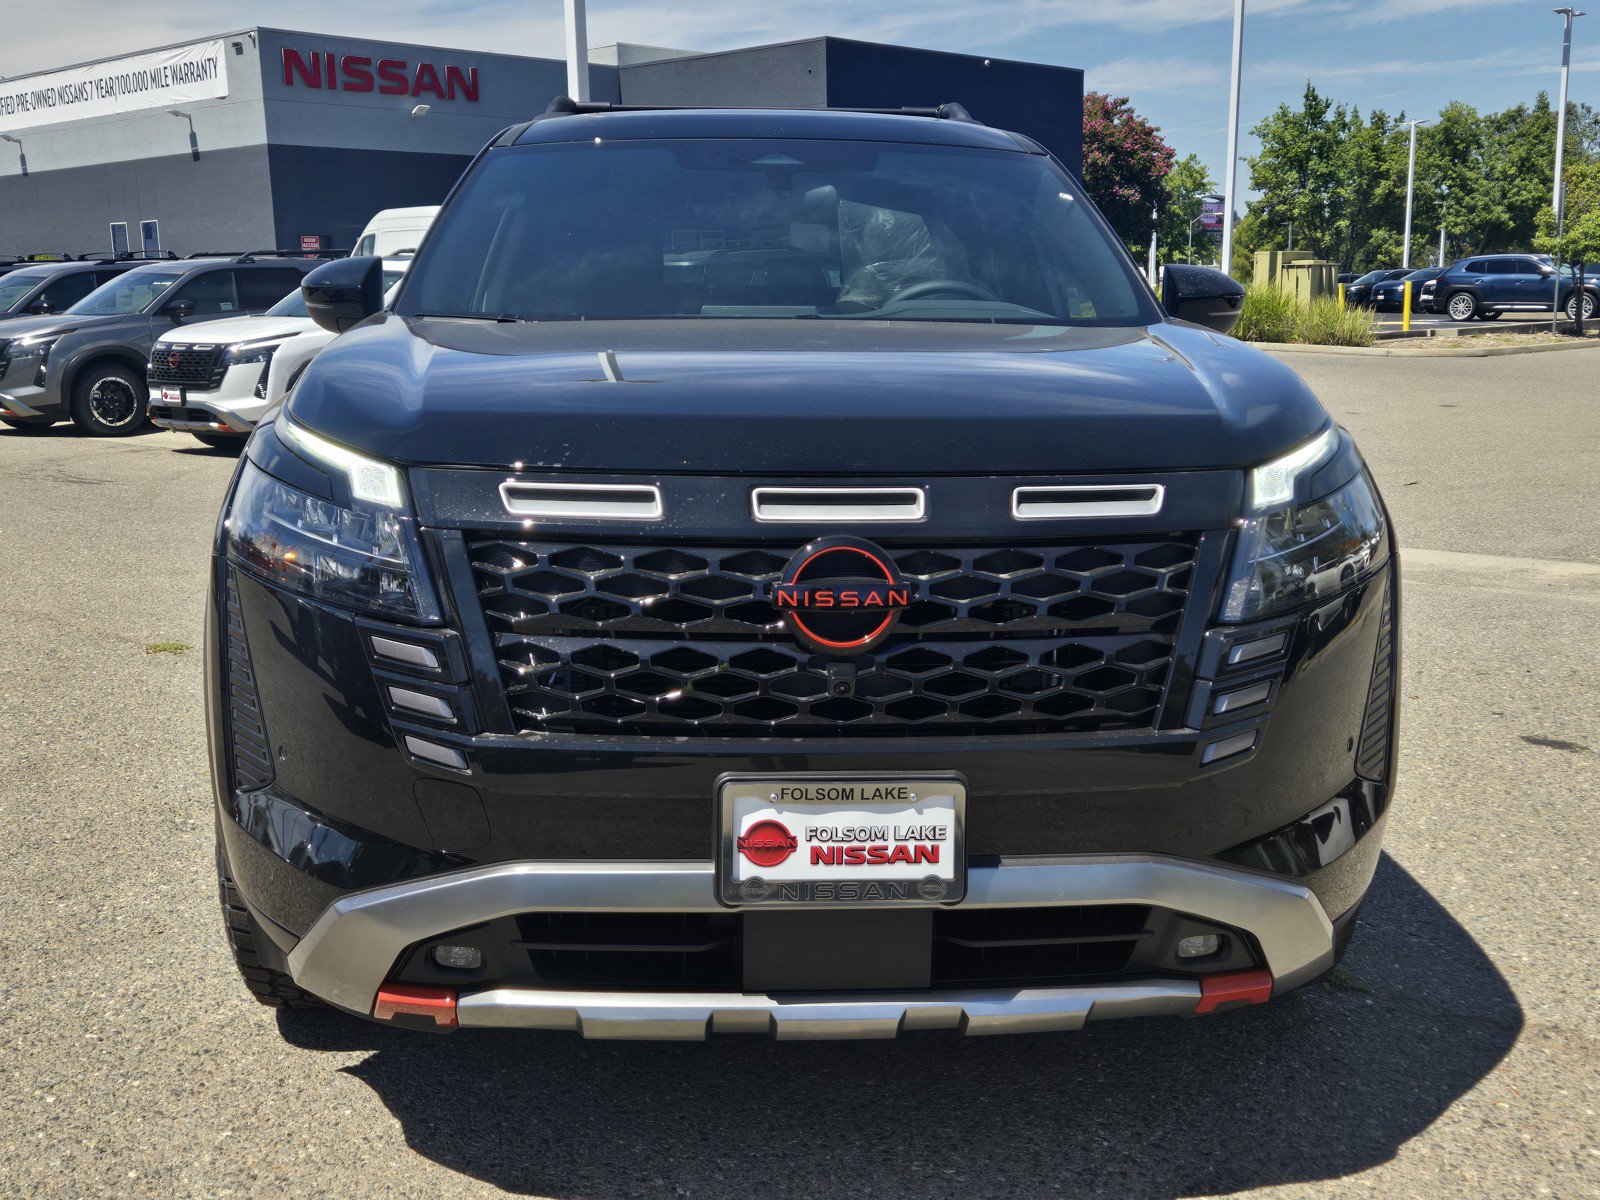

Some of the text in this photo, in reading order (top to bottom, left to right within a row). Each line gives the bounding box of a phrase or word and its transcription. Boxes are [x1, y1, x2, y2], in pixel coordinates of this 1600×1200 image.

[16, 87, 57, 113] PRE-OWNED
[57, 81, 88, 106] NISSANS
[88, 80, 93, 100] 7
[149, 66, 170, 89] MILE
[170, 56, 218, 86] WARRANTY
[281, 47, 480, 103] NISSAN
[777, 589, 908, 607] NISSAN
[780, 786, 908, 801] FOLSOM LAKE
[738, 838, 798, 848] NISSAN
[805, 824, 948, 843] FOLSOM LAKE
[810, 844, 941, 866] NISSAN
[778, 882, 908, 901] NISSAN
